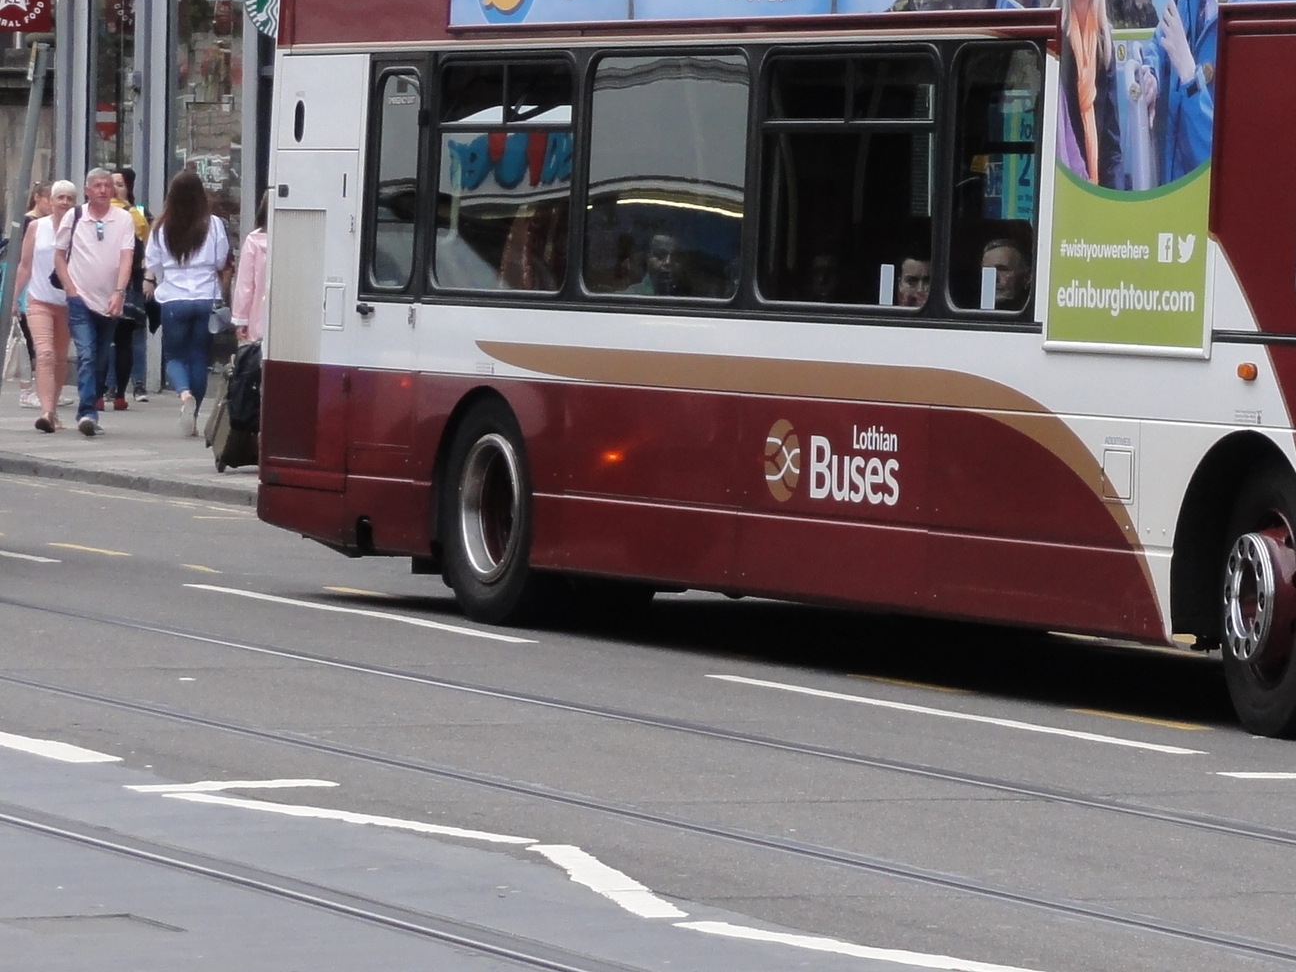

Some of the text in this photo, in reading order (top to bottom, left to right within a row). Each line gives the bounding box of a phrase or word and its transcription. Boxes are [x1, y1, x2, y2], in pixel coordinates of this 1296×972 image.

[1060, 239, 1149, 262] #wishyouwerehere
[1057, 279, 1195, 316] edinburghtour.com
[853, 424, 898, 452] Lothian
[809, 435, 900, 506] Buses
